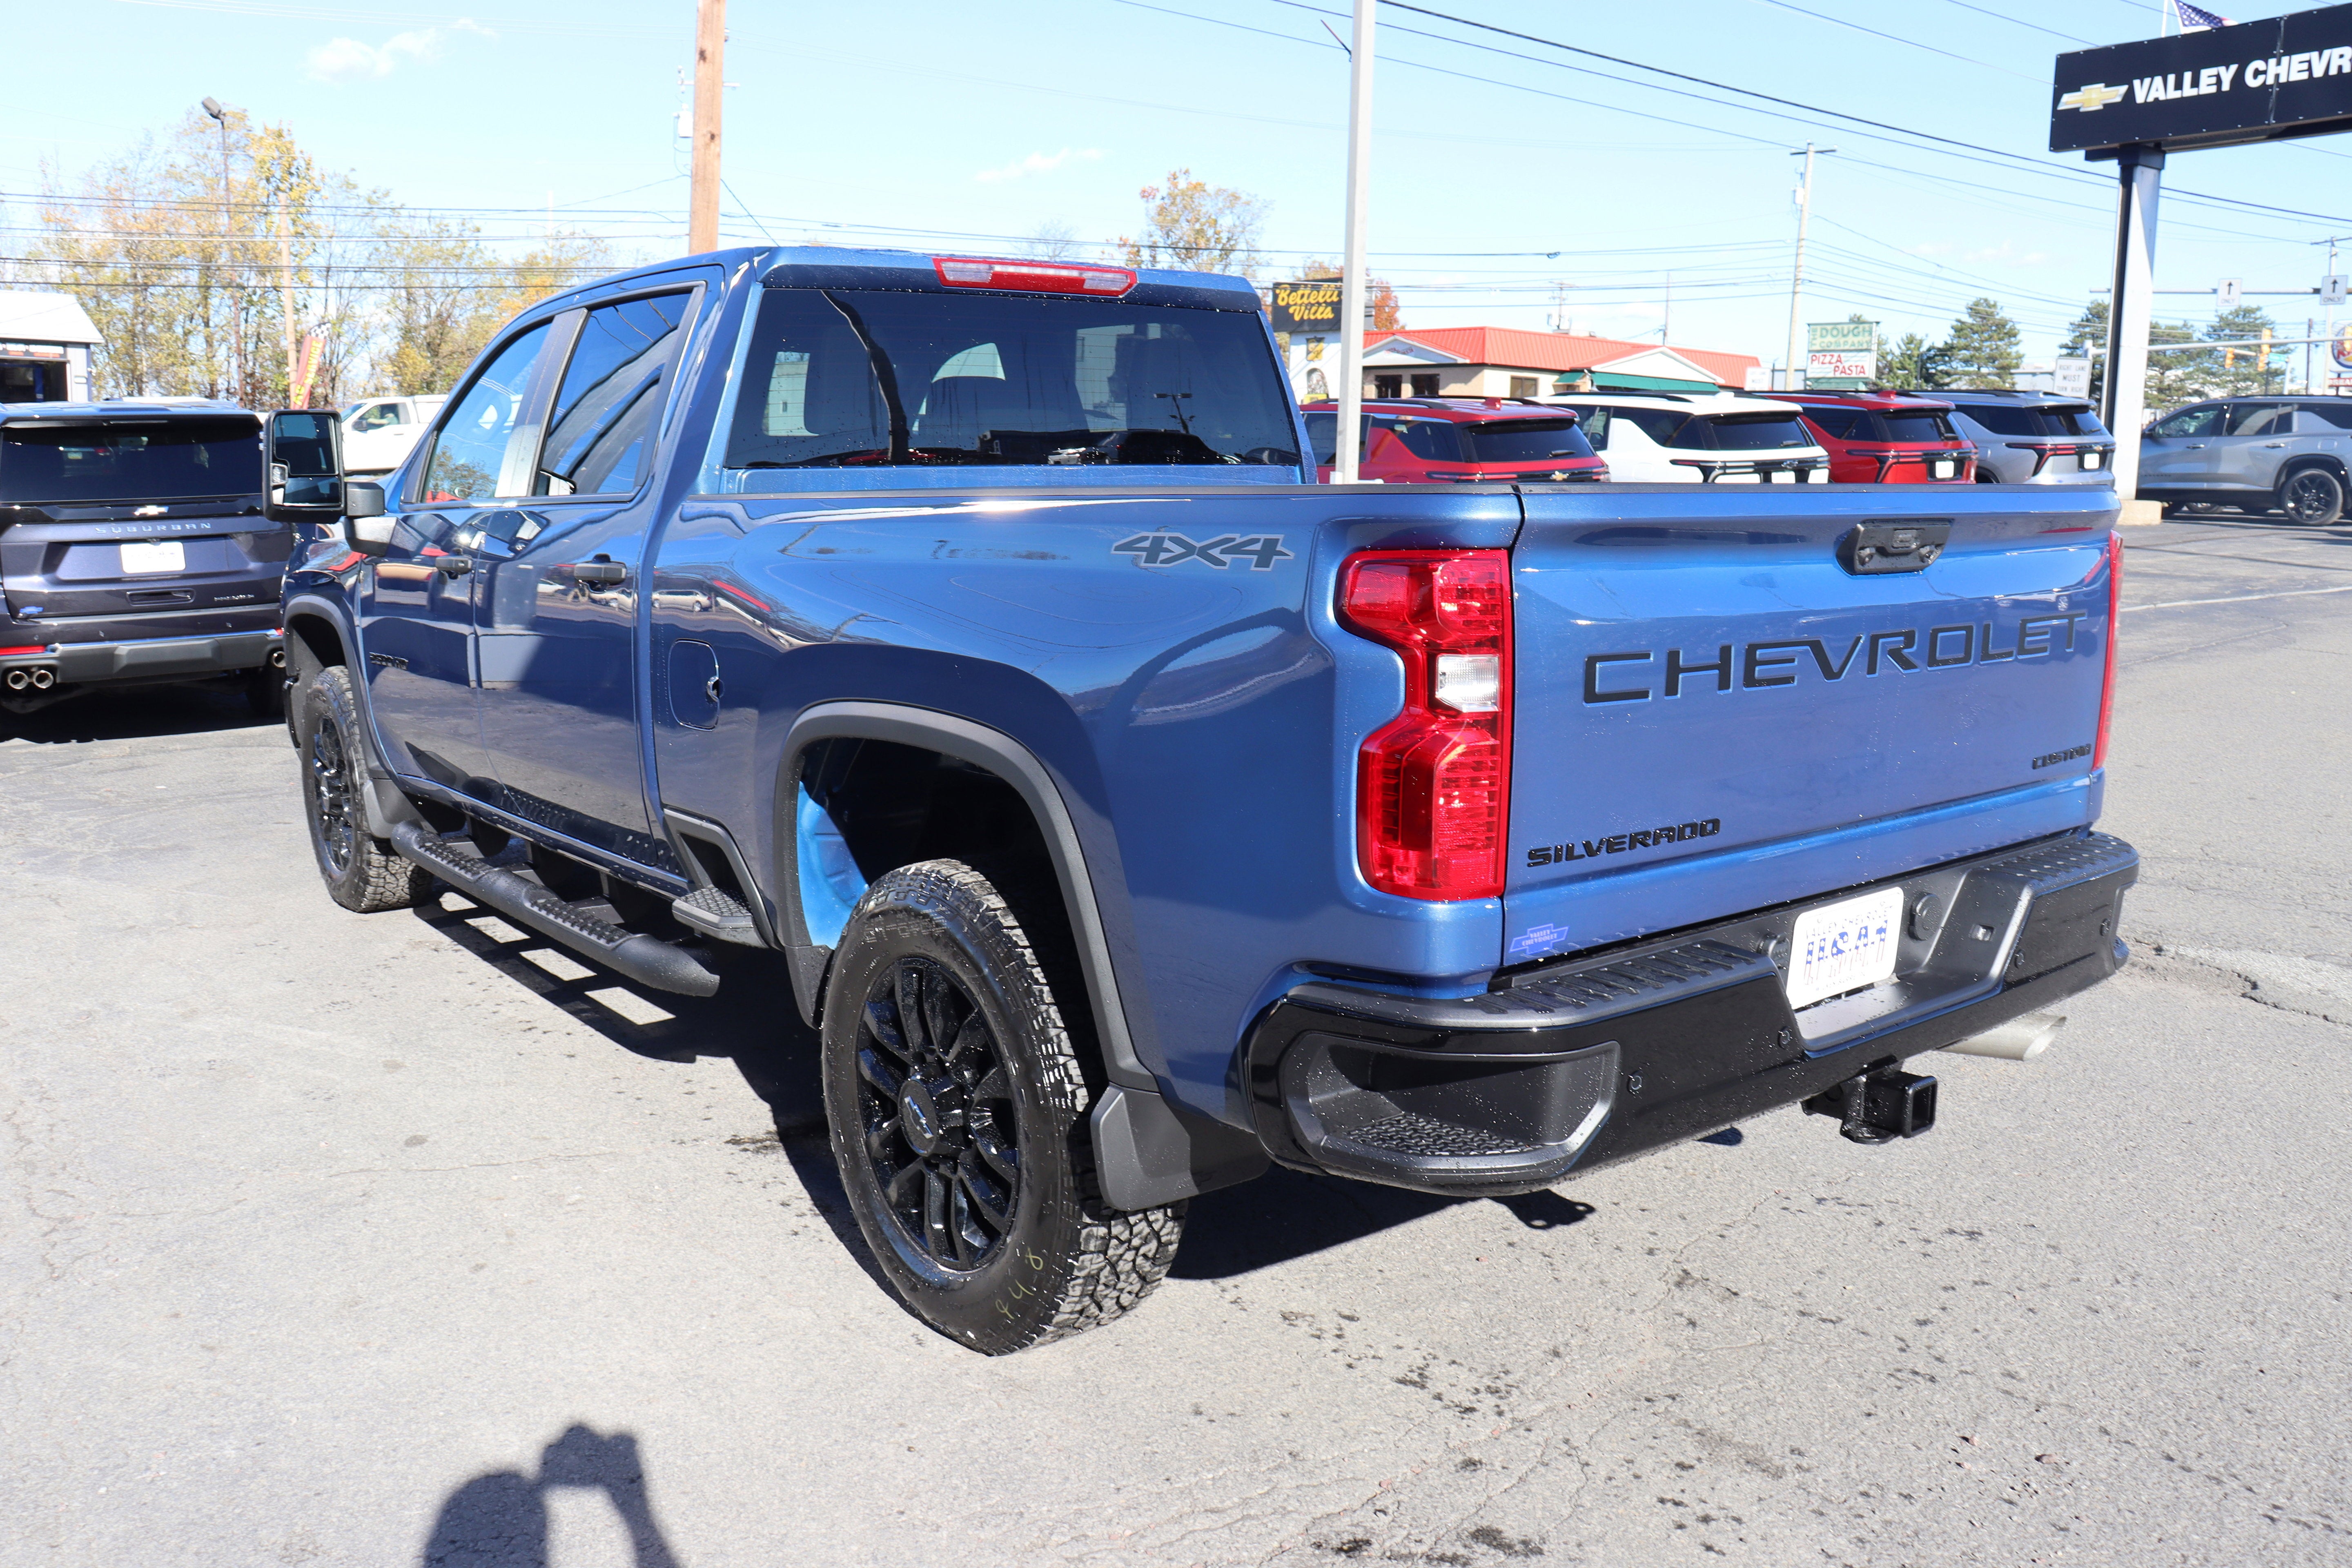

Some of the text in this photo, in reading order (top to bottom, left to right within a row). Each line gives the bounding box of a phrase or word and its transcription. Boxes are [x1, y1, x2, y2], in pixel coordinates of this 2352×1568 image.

[2132, 46, 2352, 104] VALLEY CHEVR
[1289, 303, 1334, 321] Villa
[1820, 326, 1872, 338] DOUGH
[304, 340, 323, 385] SERVICE
[1811, 354, 1843, 364] PIZZA
[1833, 365, 1866, 375] PASTA
[2062, 374, 2081, 382] MUST
[95, 523, 212, 533] SUBURBAN
[1110, 532, 1295, 571] 4X4
[1583, 612, 2087, 707] CHEVROLET
[2032, 743, 2091, 770] CUSTOM
[1527, 818, 1721, 868] SILVERADO
